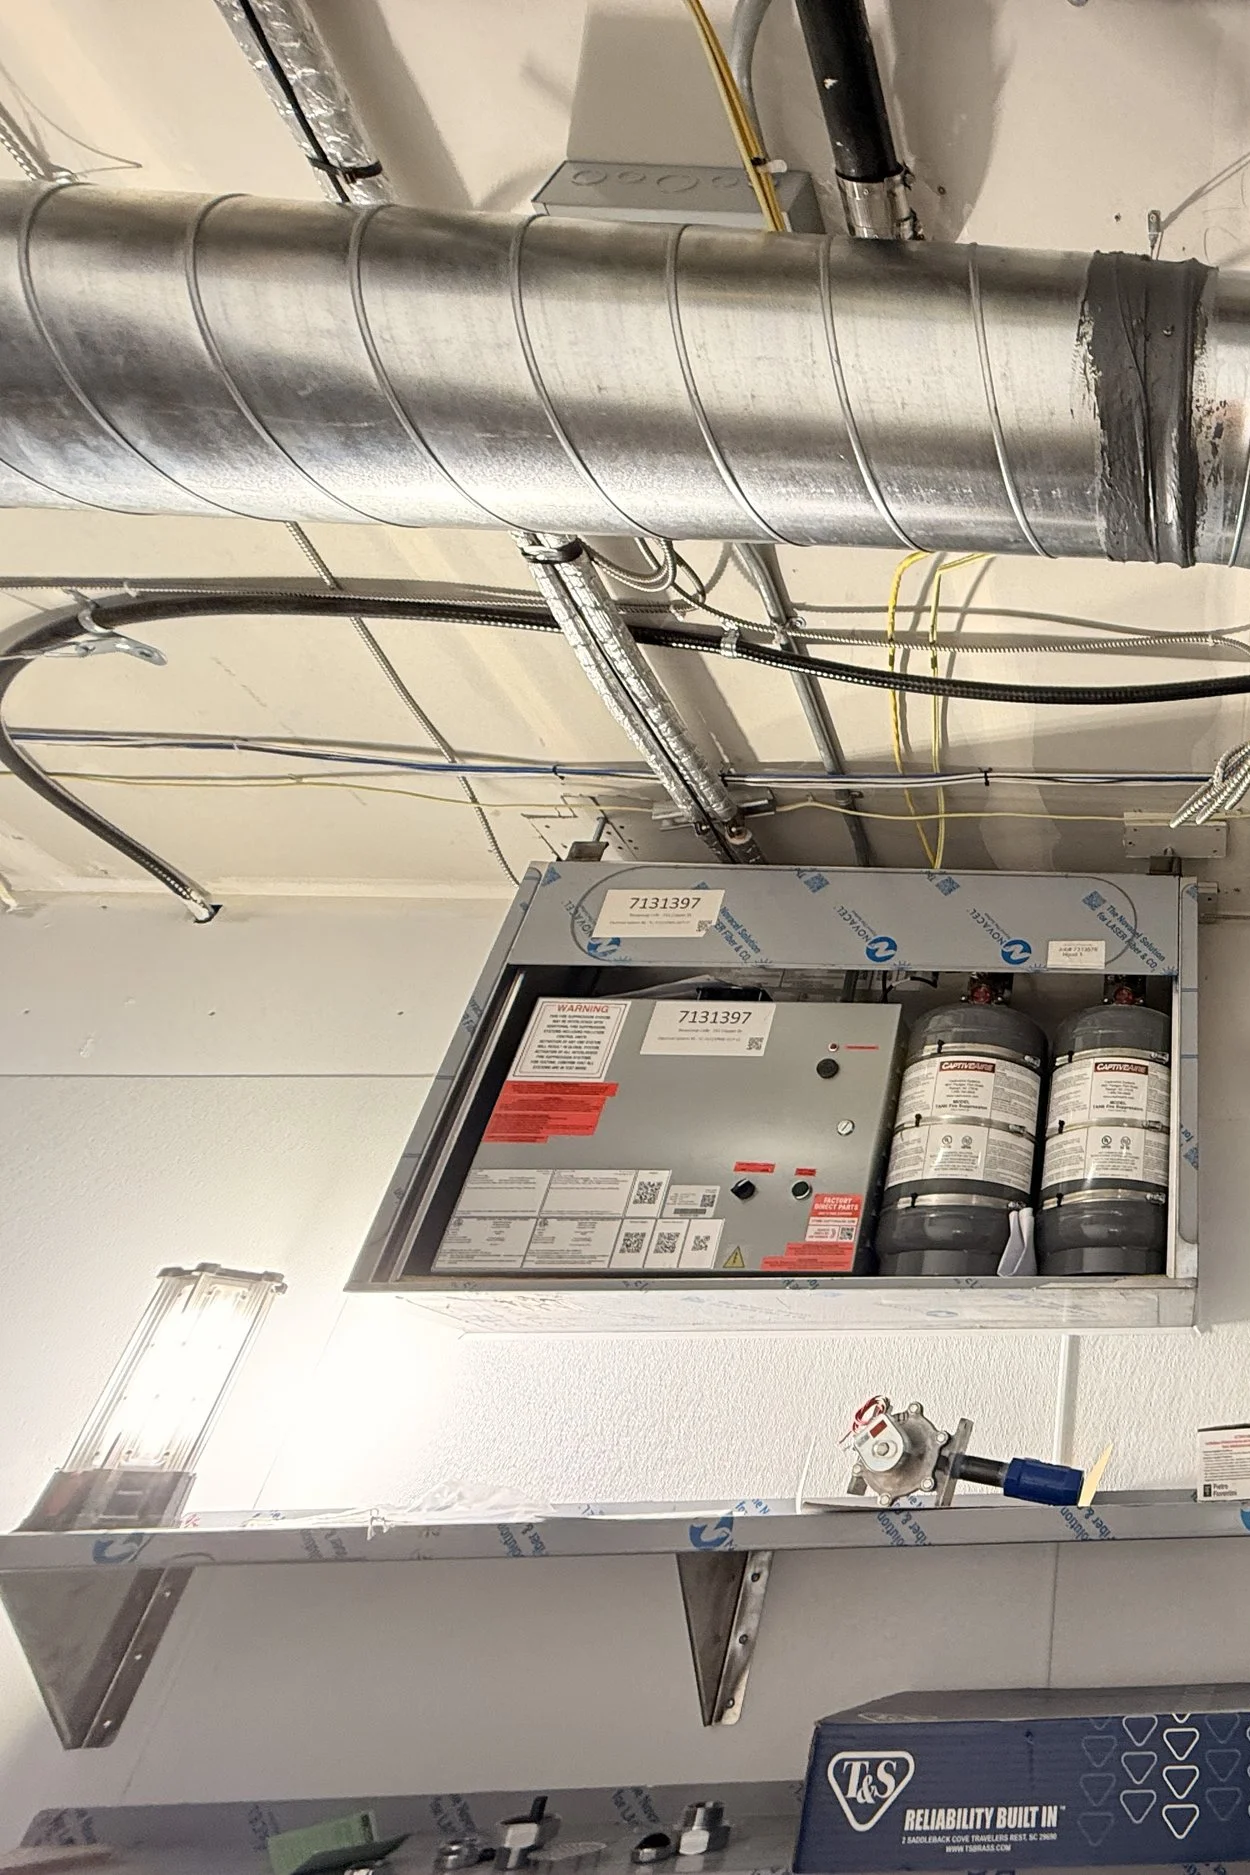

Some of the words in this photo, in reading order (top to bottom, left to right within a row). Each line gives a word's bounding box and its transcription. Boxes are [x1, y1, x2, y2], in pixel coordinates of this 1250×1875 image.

[629, 897, 702, 910] 7131397
[836, 905, 871, 942] NOVACEL
[970, 908, 1007, 946] NOVACEL
[1097, 911, 1108, 923] for
[1105, 919, 1127, 942] LASER
[1106, 904, 1119, 918] The
[1139, 935, 1166, 962] Solution
[557, 1005, 609, 1013] WARNING
[678, 1010, 752, 1024] 7131397
[843, 1760, 897, 1804] T&S
[903, 1807, 994, 1831] RELIABILITY
[996, 1806, 1040, 1829] BUILT
[1041, 1805, 1058, 1828] IN
[902, 1836, 907, 1844] 2
[907, 1836, 950, 1844] SADDLEBACK
[952, 1835, 969, 1843] COVE
[971, 1834, 1008, 1842] TRAVELERS
